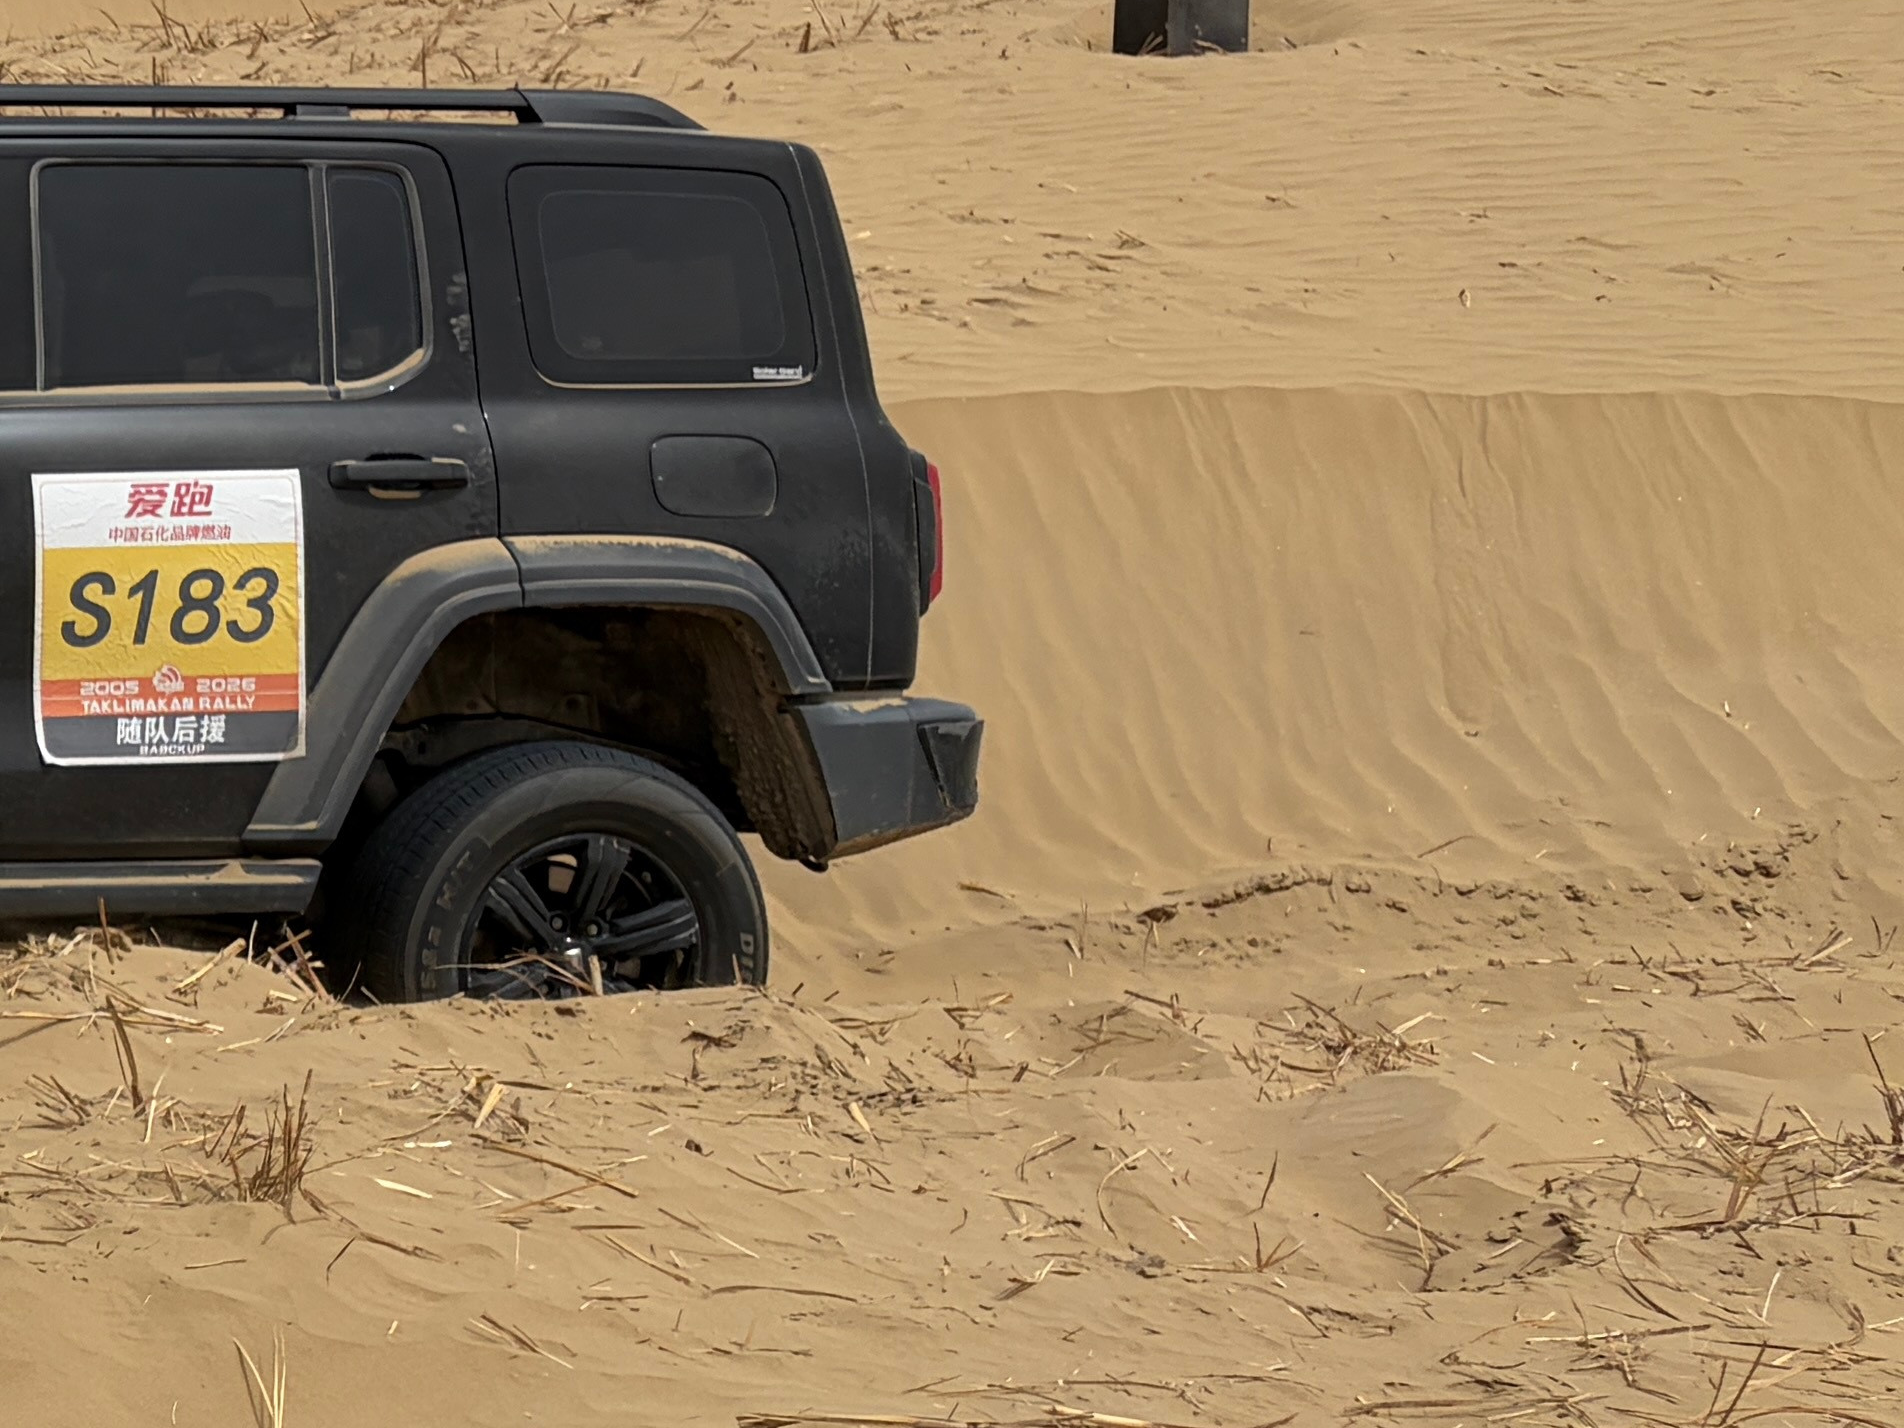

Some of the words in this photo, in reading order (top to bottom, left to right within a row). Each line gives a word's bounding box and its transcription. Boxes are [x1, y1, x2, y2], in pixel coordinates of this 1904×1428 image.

[125, 480, 214, 518] 爱跑
[108, 524, 231, 543] 中国石化品牌燃油
[60, 567, 279, 648] S183
[79, 680, 139, 695] 2005
[196, 677, 256, 693] 2026
[81, 696, 194, 715] TAKLIMAKAN
[199, 695, 256, 711] RALLY
[117, 714, 226, 745] 随队后援
